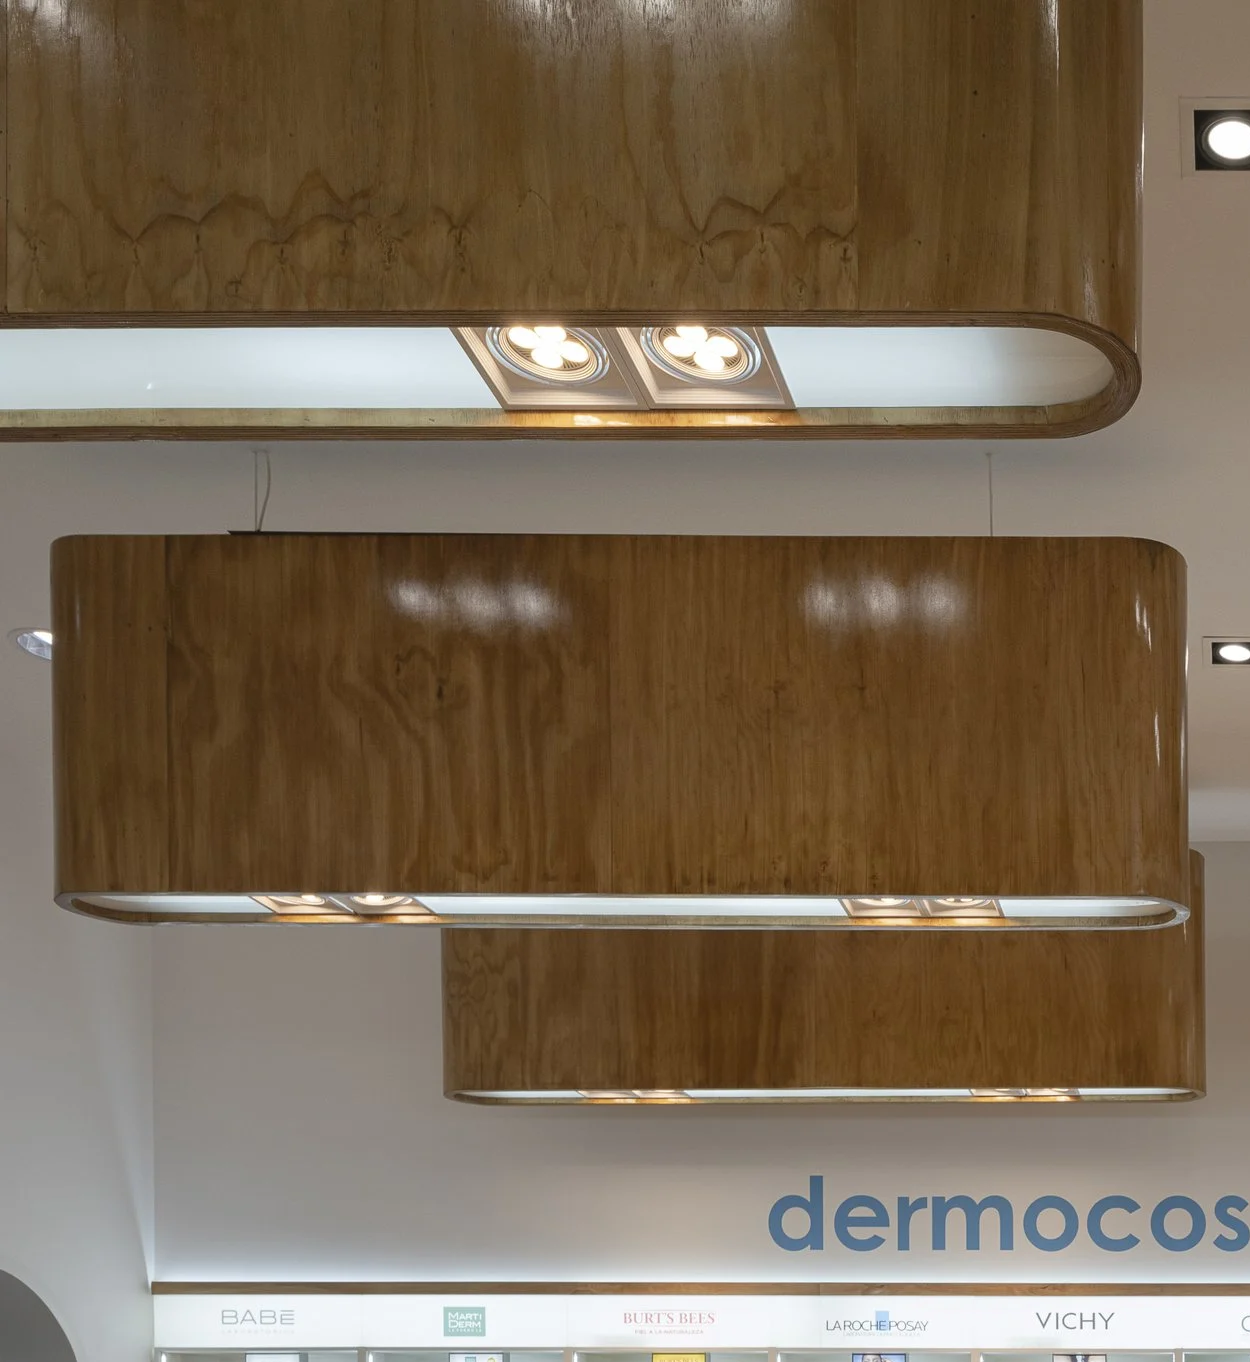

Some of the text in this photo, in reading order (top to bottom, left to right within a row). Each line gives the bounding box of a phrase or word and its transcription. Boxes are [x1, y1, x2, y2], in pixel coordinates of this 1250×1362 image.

[448, 1312, 482, 1320] MARTI
[623, 1311, 715, 1324] BURT'S BEES
[1036, 1312, 1115, 1330] VICHY
[448, 1320, 481, 1328] DERM
[889, 1320, 928, 1331] POSAY
